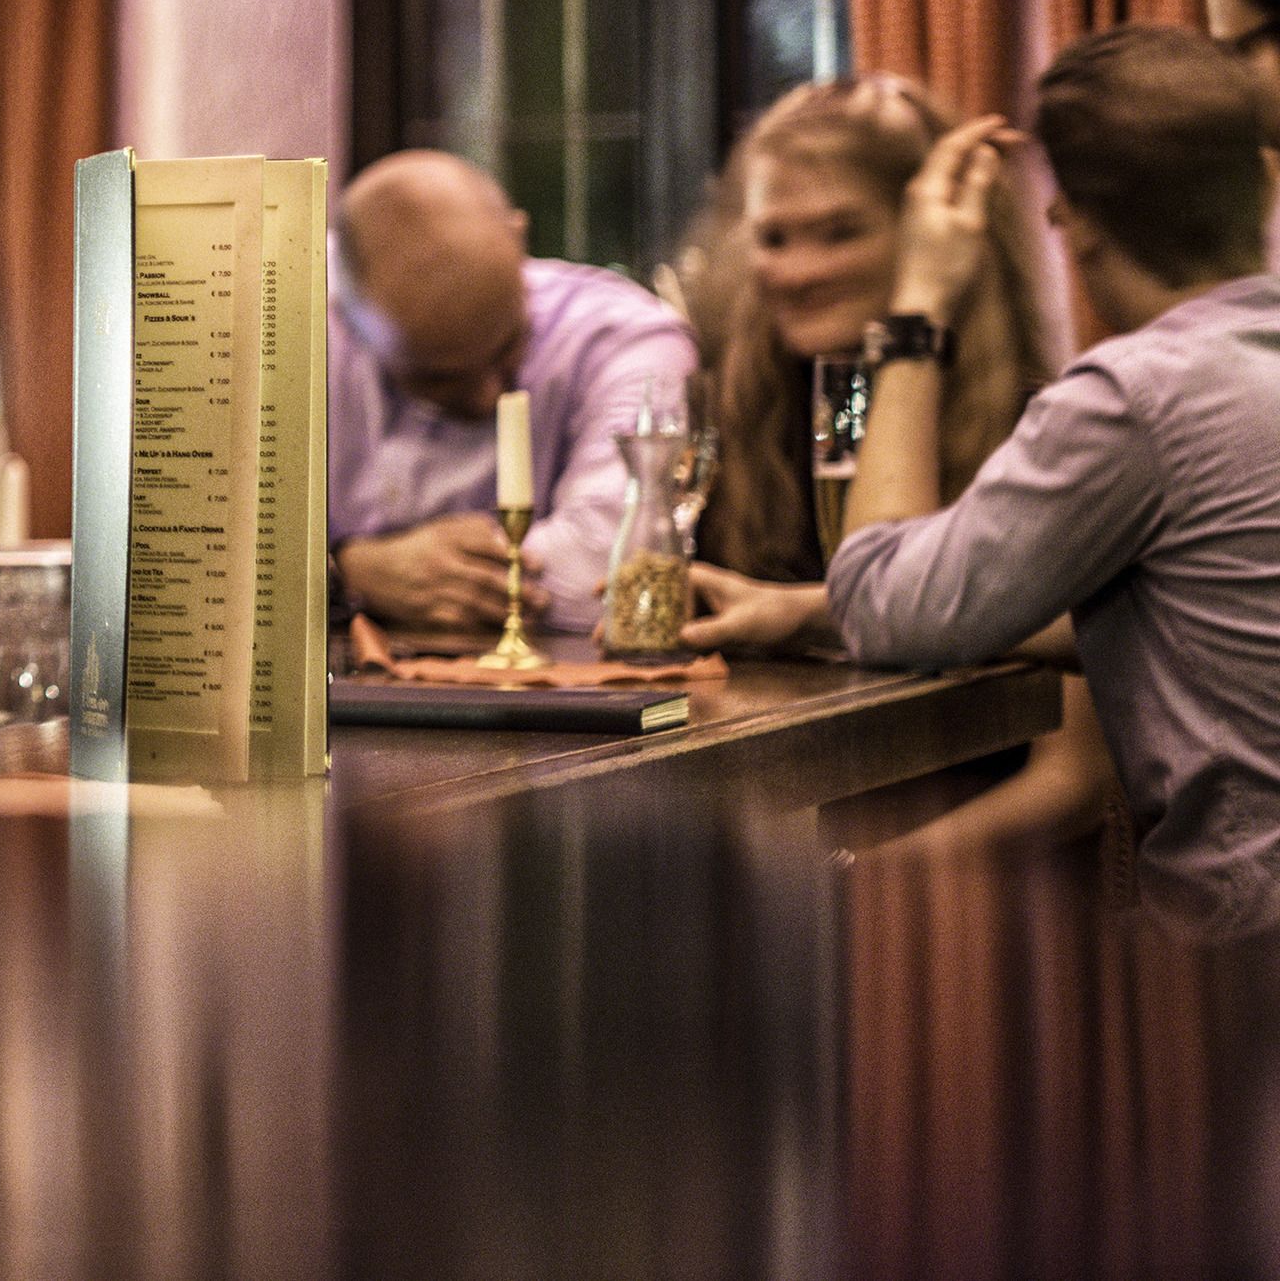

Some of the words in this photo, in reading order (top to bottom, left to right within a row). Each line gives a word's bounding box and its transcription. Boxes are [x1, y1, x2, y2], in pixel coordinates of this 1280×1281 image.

[140, 271, 166, 279] PASSION
[144, 315, 165, 323] FIZZES
[138, 525, 171, 533] COCKTAILS
[178, 525, 200, 533] FANCY
[201, 526, 224, 534] DRINKS
